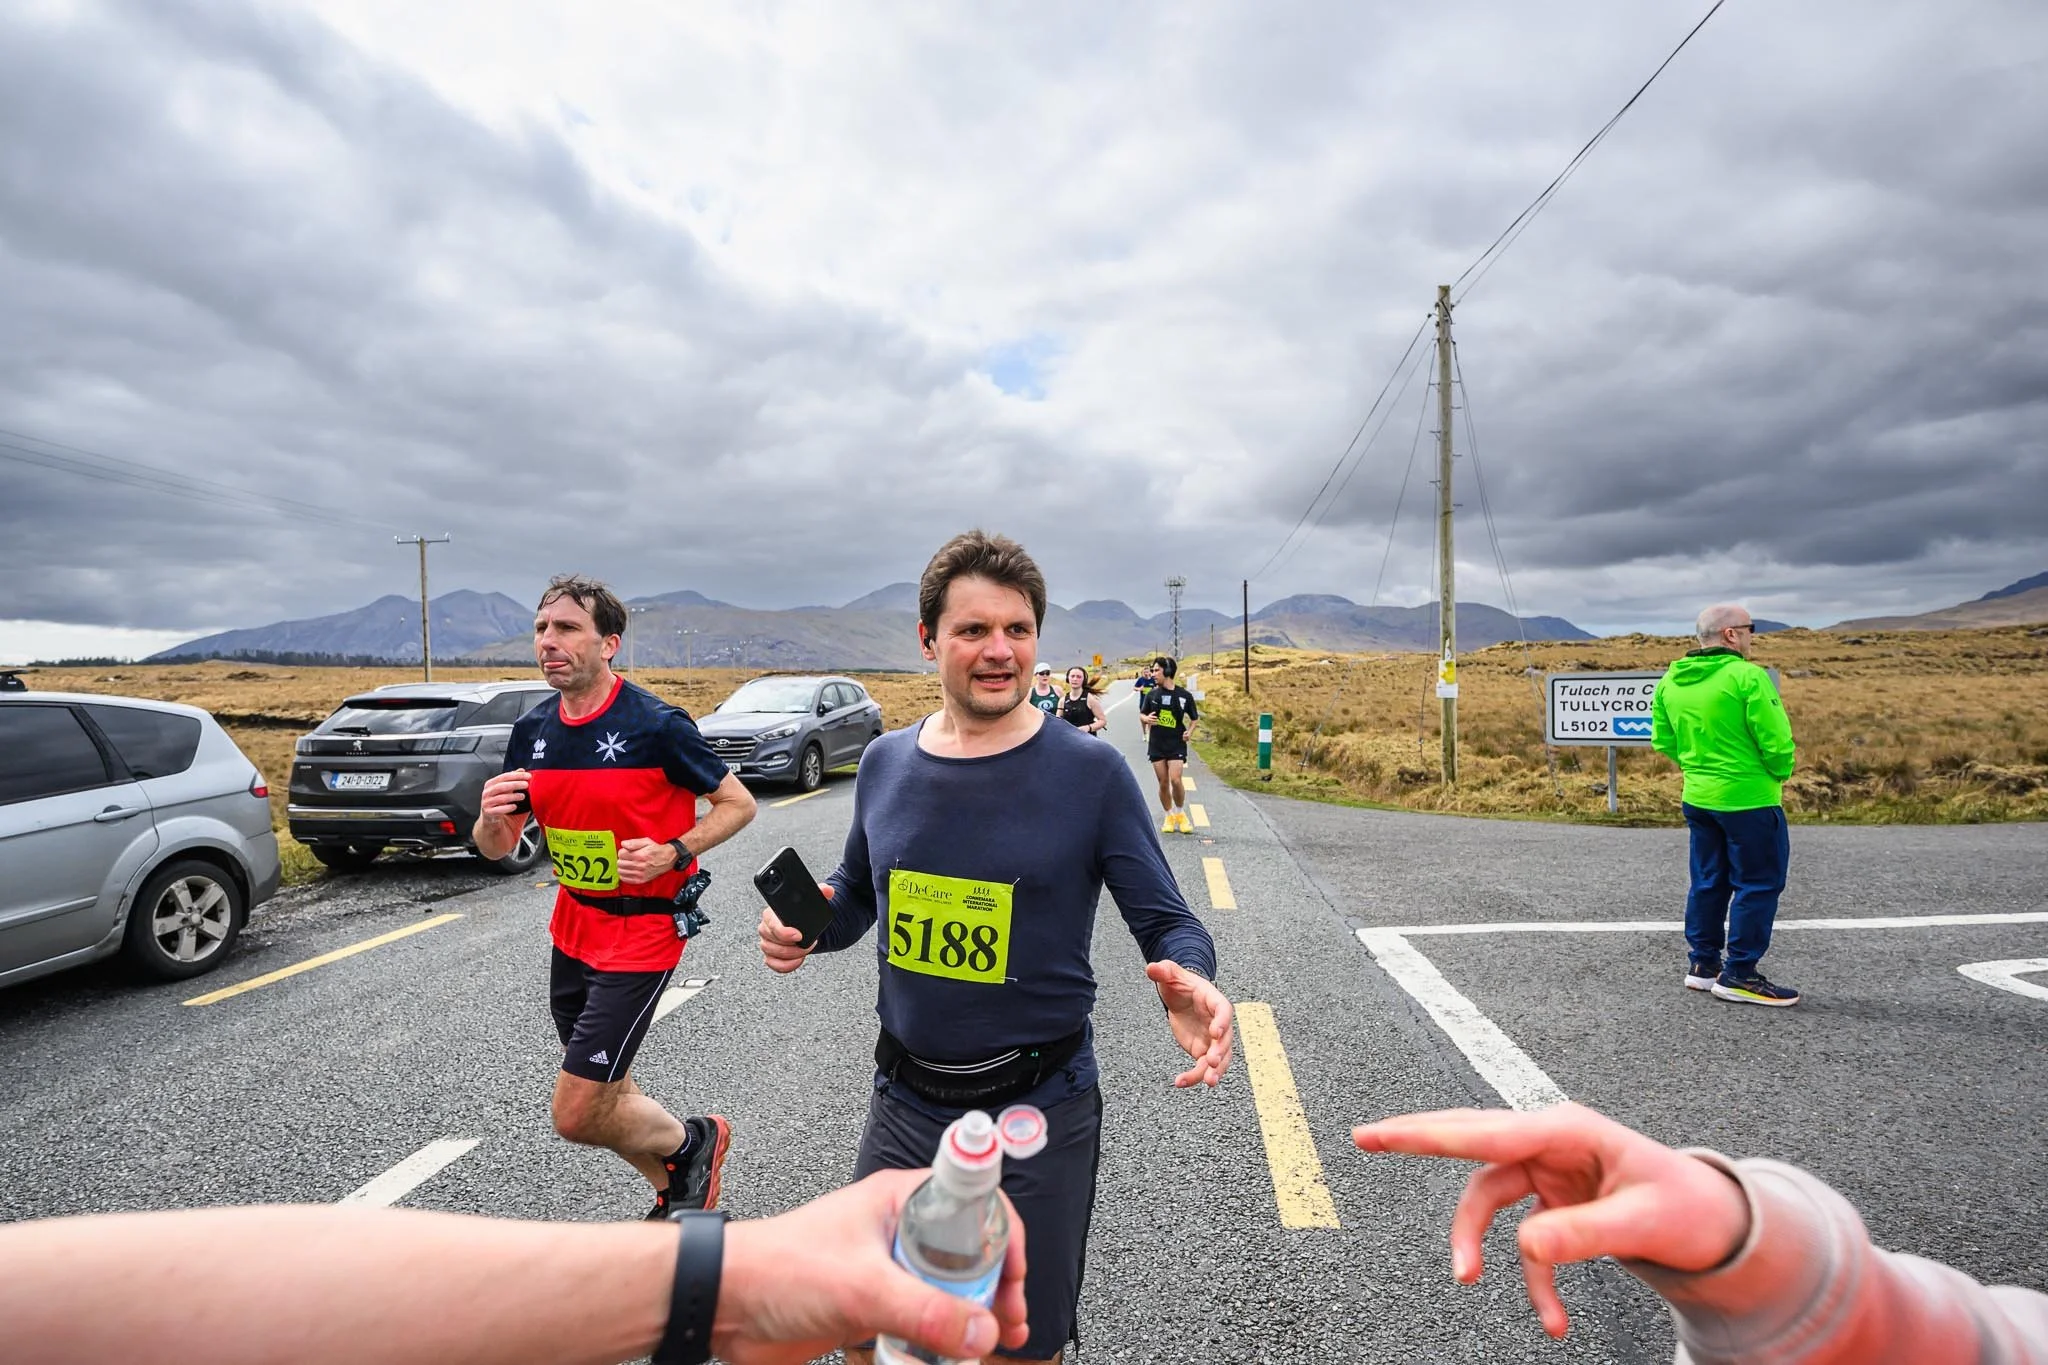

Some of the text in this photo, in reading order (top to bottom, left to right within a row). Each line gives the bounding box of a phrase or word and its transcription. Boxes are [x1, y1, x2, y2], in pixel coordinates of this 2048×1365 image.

[1560, 684, 1654, 696] Tulach na C
[1560, 700, 1653, 711] TULLYCRO
[1561, 721, 1608, 732] L5102
[341, 775, 385, 786] 241-D-13122
[552, 850, 613, 884] 5522
[908, 881, 953, 900] DeCare
[962, 899, 998, 908] INTERNATIONAL
[893, 911, 999, 973] 5188
